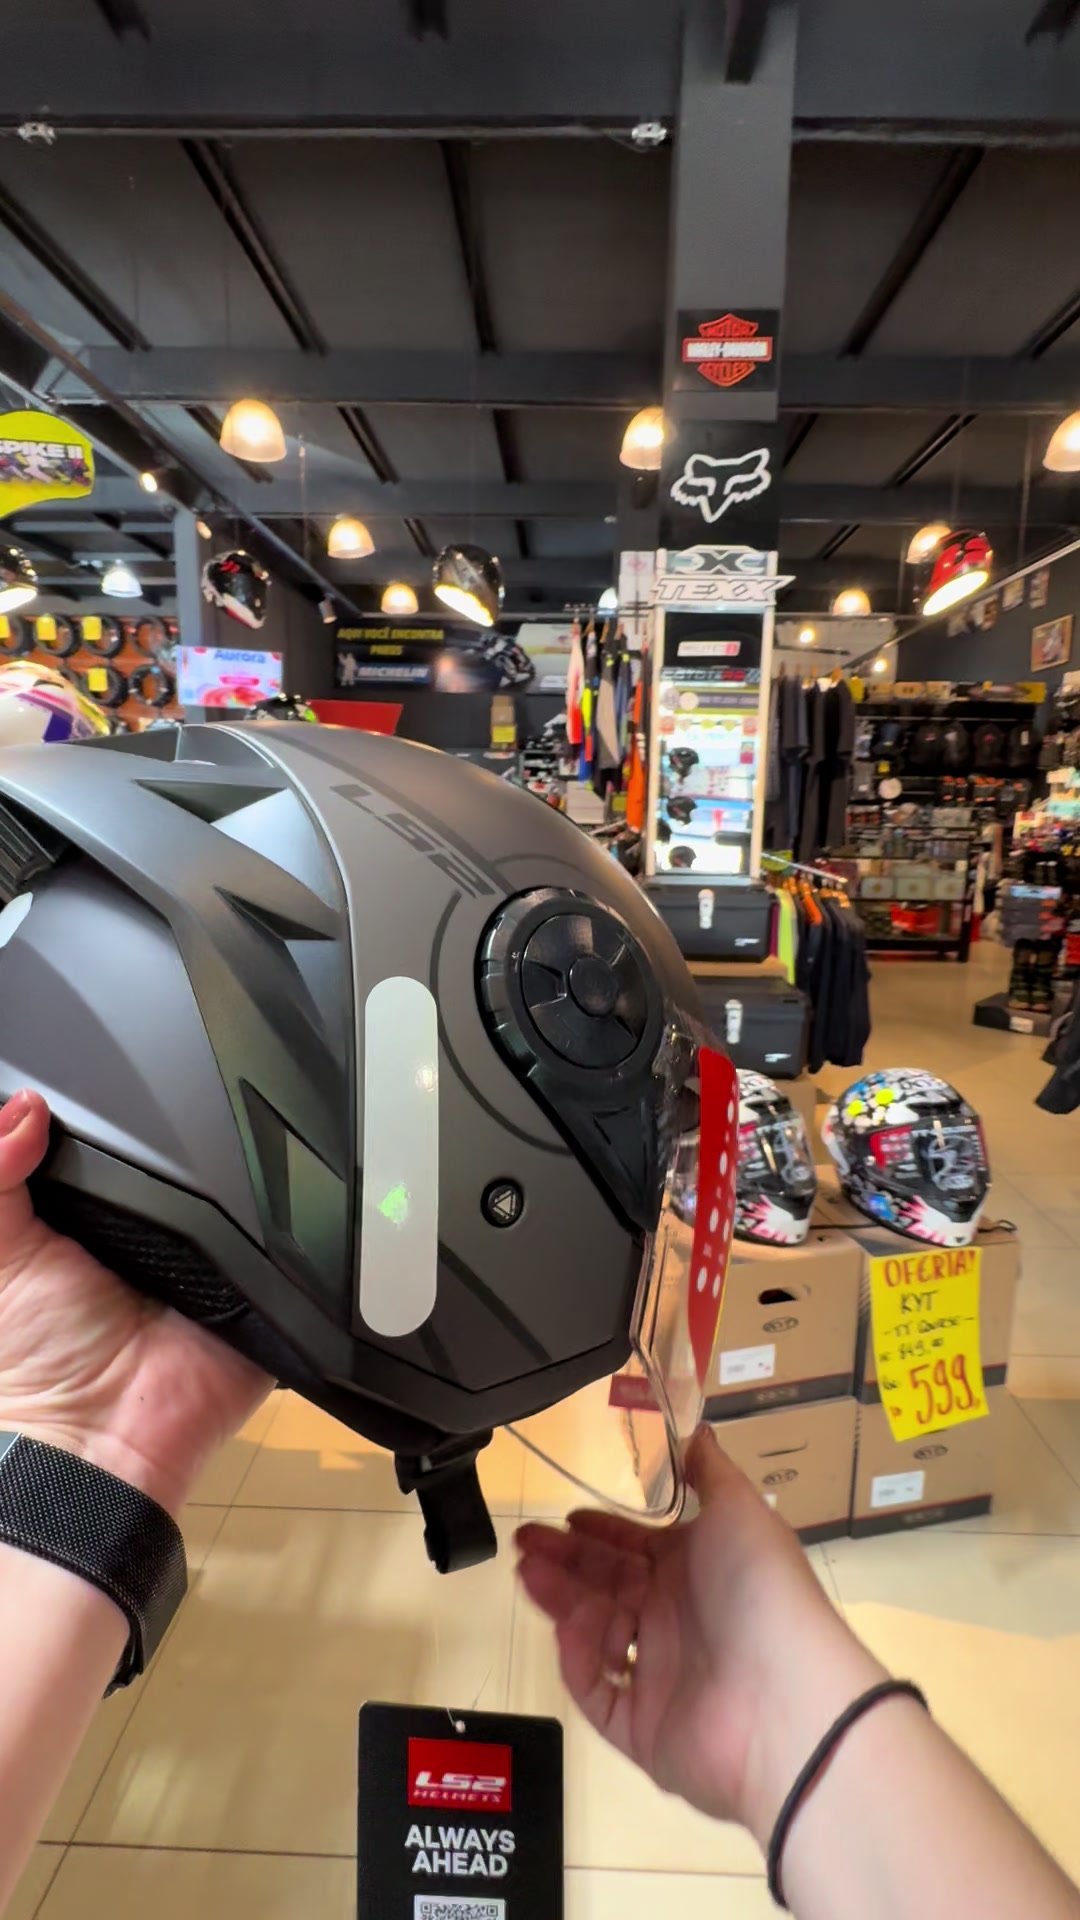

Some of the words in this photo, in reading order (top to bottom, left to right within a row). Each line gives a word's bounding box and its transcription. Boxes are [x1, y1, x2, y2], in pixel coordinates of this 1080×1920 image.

[658, 578, 784, 602] TEXX
[214, 650, 266, 664] Aurora
[358, 666, 429, 678] MICHELIN
[329, 783, 497, 900] LS2
[901, 1290, 940, 1315] KYT
[415, 1771, 507, 1793] LS2
[404, 1824, 516, 1853] ALWAYS
[411, 1850, 508, 1877] AHEAD
